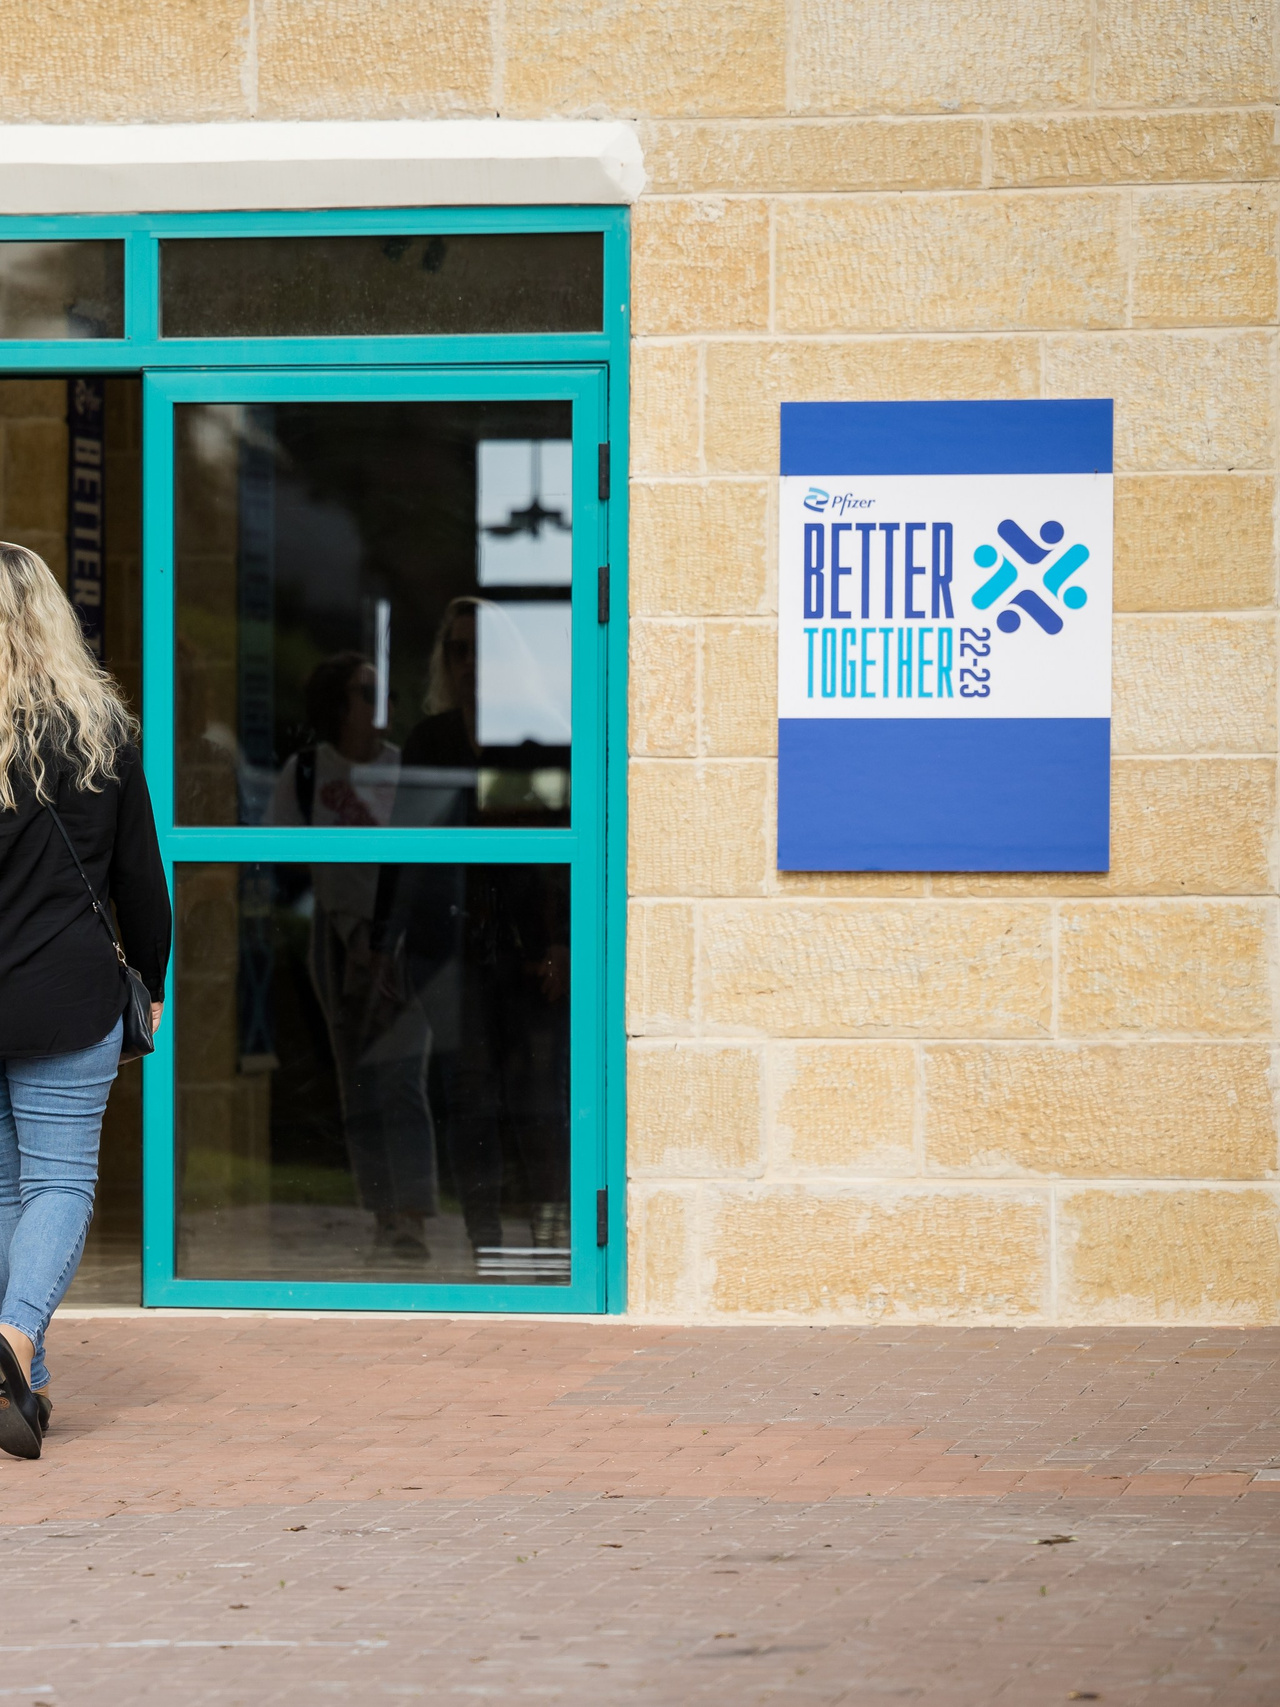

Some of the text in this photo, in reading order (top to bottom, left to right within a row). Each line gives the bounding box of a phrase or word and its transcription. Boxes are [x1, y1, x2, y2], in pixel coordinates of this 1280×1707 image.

[73, 436, 102, 607] BETTER
[831, 493, 875, 516] Pfizer
[804, 522, 955, 619] BETTER
[803, 627, 954, 698] TOGETHER
[959, 627, 991, 698] 22-23
